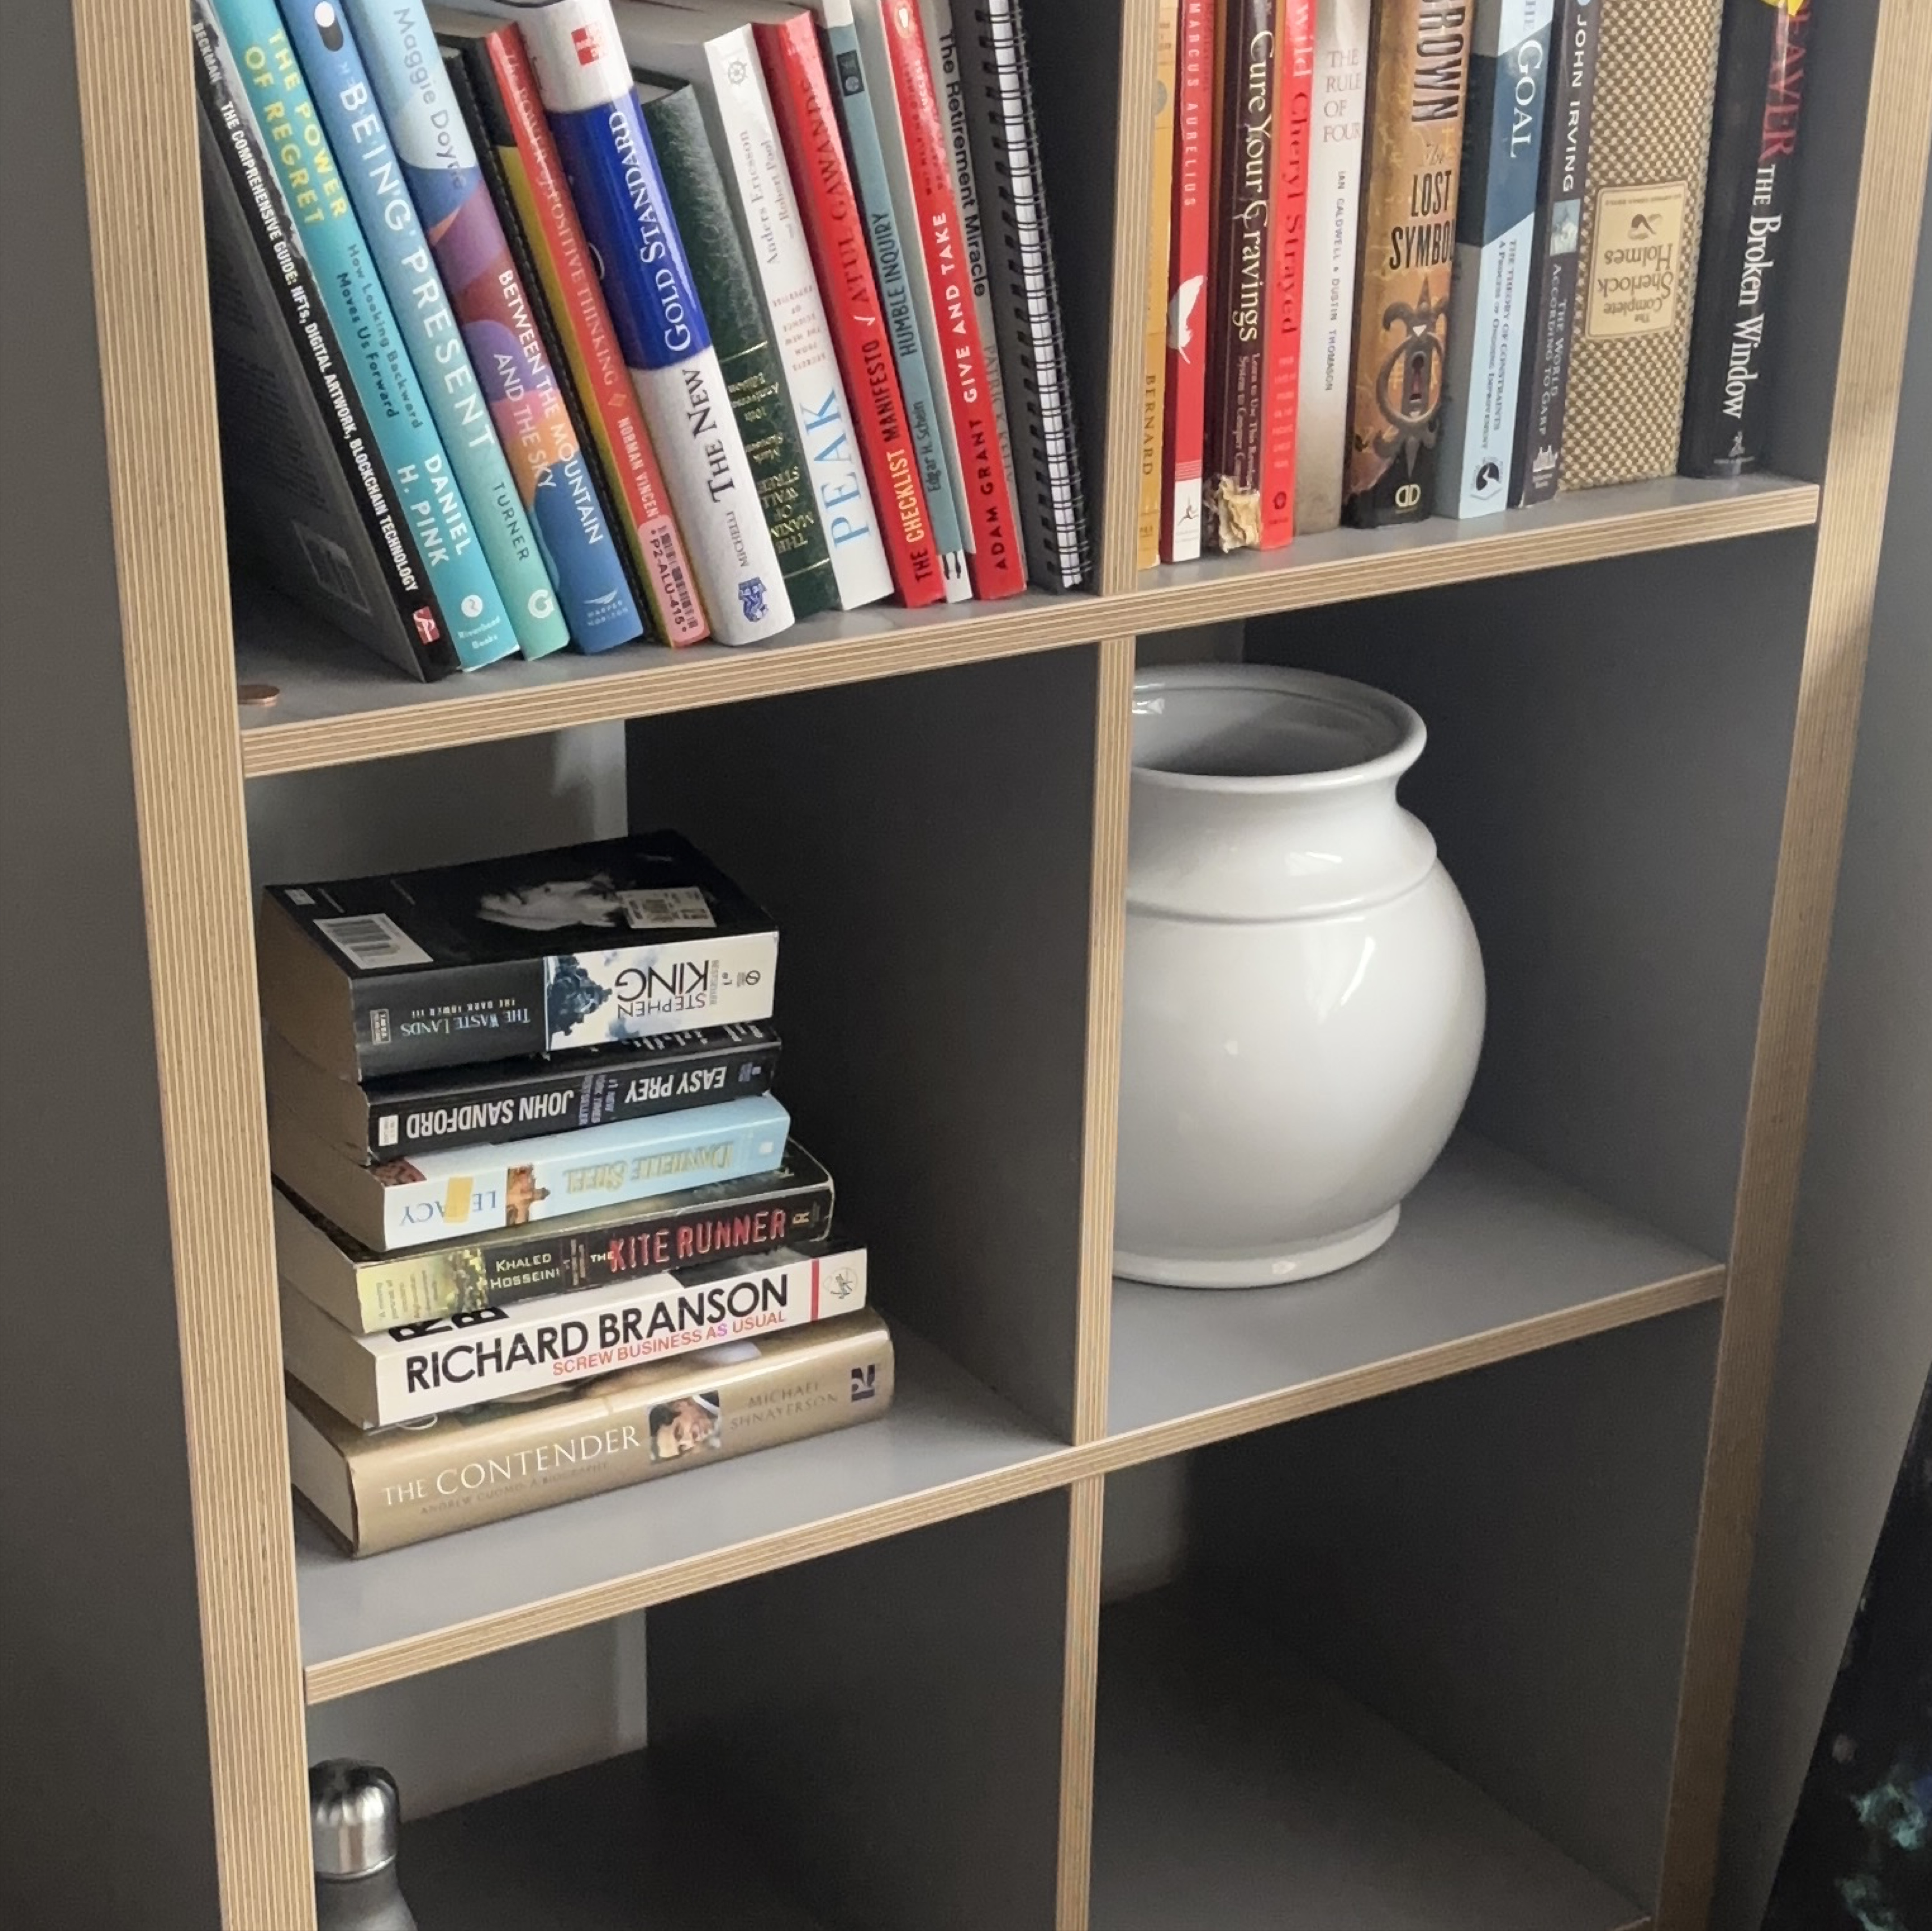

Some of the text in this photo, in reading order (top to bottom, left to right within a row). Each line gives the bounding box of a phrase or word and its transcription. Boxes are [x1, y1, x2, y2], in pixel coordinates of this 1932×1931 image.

[393, 7, 436, 105] Maggie
[1326, 73, 1363, 93] RULE
[1328, 49, 1360, 68] THE
[1411, 0, 1466, 122] ROWN
[1510, 40, 1544, 159] GOAL
[1758, 0, 1811, 162] EAVER
[245, 46, 325, 223] OF REGRET
[269, 28, 348, 218] THE POWER
[1184, 2, 1202, 207] MARCUS AURELIUS
[1282, 91, 1309, 200] Cheryl
[1322, 122, 1363, 143] FOUR
[1323, 100, 1347, 118] OF
[1563, 14, 1587, 192] JOHN IRVING
[739, 130, 779, 265] Anders Ericsson
[939, 33, 987, 297] The Retirement Miracle
[1232, 30, 1275, 342] Cure Your Cravings
[1411, 170, 1452, 217] LOST
[340, 82, 496, 448] BEING PRESENT
[837, 238, 869, 303] ATUL
[871, 212, 918, 357] HUMBLE INQUIRY
[932, 212, 955, 275] TAKE
[1276, 213, 1303, 335] Strayed
[1597, 271, 1674, 299] Sherlock
[1604, 242, 1673, 272] Holmes
[347, 244, 423, 429] How Looking Backward
[577, 287, 619, 386] THINKING
[608, 111, 736, 503] THE NEW GOLD STANDARD
[945, 285, 967, 335] AND
[1545, 264, 1562, 361] ACCORDING
[1603, 297, 1663, 316] Complete
[1722, 164, 1782, 420] THE Broken Window
[221, 102, 237, 130] THE
[232, 130, 283, 241] COMPREHENSIVE
[273, 242, 299, 285] GUIDE:
[305, 322, 332, 372] DIGITAL
[324, 373, 357, 440] ARTWORK,
[350, 438, 389, 515] BLOCKCHAIN
[379, 514, 418, 592] TECHNOLOGY
[336, 272, 399, 418] Moves Us Forward
[956, 345, 978, 403] GIVE
[1550, 337, 1564, 397] WORLD
[493, 352, 556, 488] AND THE SKY
[498, 269, 604, 545] BETWEEN THE MOUNTAIN
[1143, 375, 1156, 475] BERNARD
[1539, 391, 1550, 435] GARP
[424, 454, 473, 555] DANIEL
[617, 418, 660, 518] NORMAN VINCEN
[799, 389, 870, 550] PEAK
[861, 340, 932, 582] THE CHECKLIST MANIFESTO
[968, 419, 1008, 571] ADAM GRANT
[397, 464, 449, 566] H. PINK
[492, 482, 530, 562] TURNER
[725, 510, 750, 568] MICHELLI
[505, 1008, 531, 1024] THE
[615, 959, 710, 1002] KING
[617, 991, 707, 1020] STEPHEN
[400, 1018, 450, 1036] LANDS
[406, 1099, 514, 1139] SANDFORD
[518, 1090, 574, 1122] JOHN
[625, 1074, 674, 1104] PREY
[676, 1066, 727, 1096] EASY
[399, 1189, 496, 1227] LEACY
[590, 1252, 614, 1264] THE
[609, 1231, 669, 1273] KITE
[676, 1209, 787, 1260] RUNNER
[490, 1269, 560, 1290] HOSSEINI
[496, 1252, 552, 1272] KHALED
[406, 1320, 589, 1394] RICHARD
[598, 1273, 788, 1350] BRANSON
[552, 1310, 787, 1376] SCREW BUSINESS AS USUAL
[730, 1393, 839, 1430] SHNAYERSON
[747, 1382, 820, 1409] MICHAEL
[381, 1424, 642, 1506] THE CONTENDER
